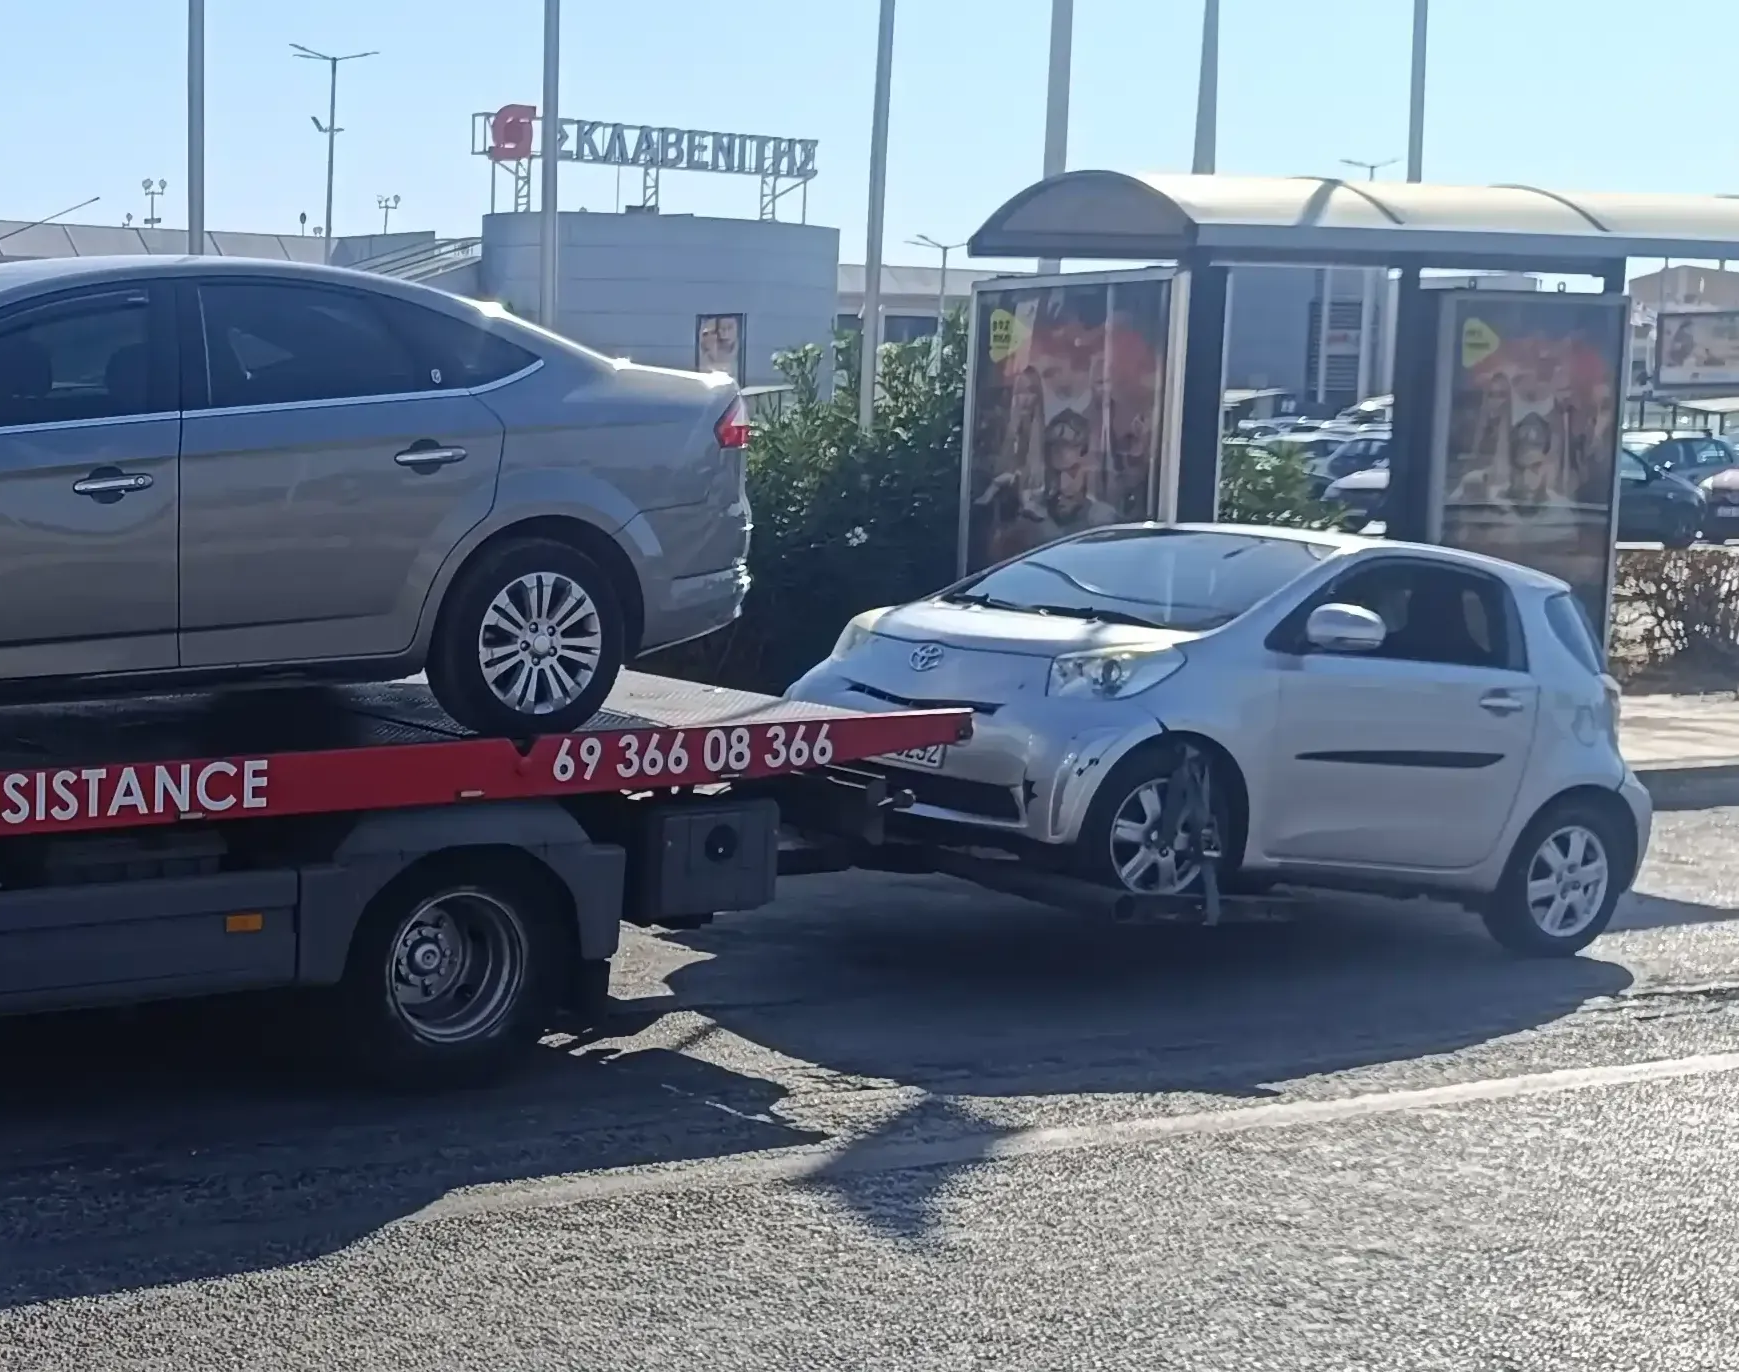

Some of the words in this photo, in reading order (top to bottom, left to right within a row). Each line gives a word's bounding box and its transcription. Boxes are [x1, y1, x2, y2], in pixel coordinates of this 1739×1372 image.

[552, 737, 602, 782] 69
[616, 731, 689, 778] 366
[703, 727, 751, 772] 08
[764, 723, 833, 768] 366
